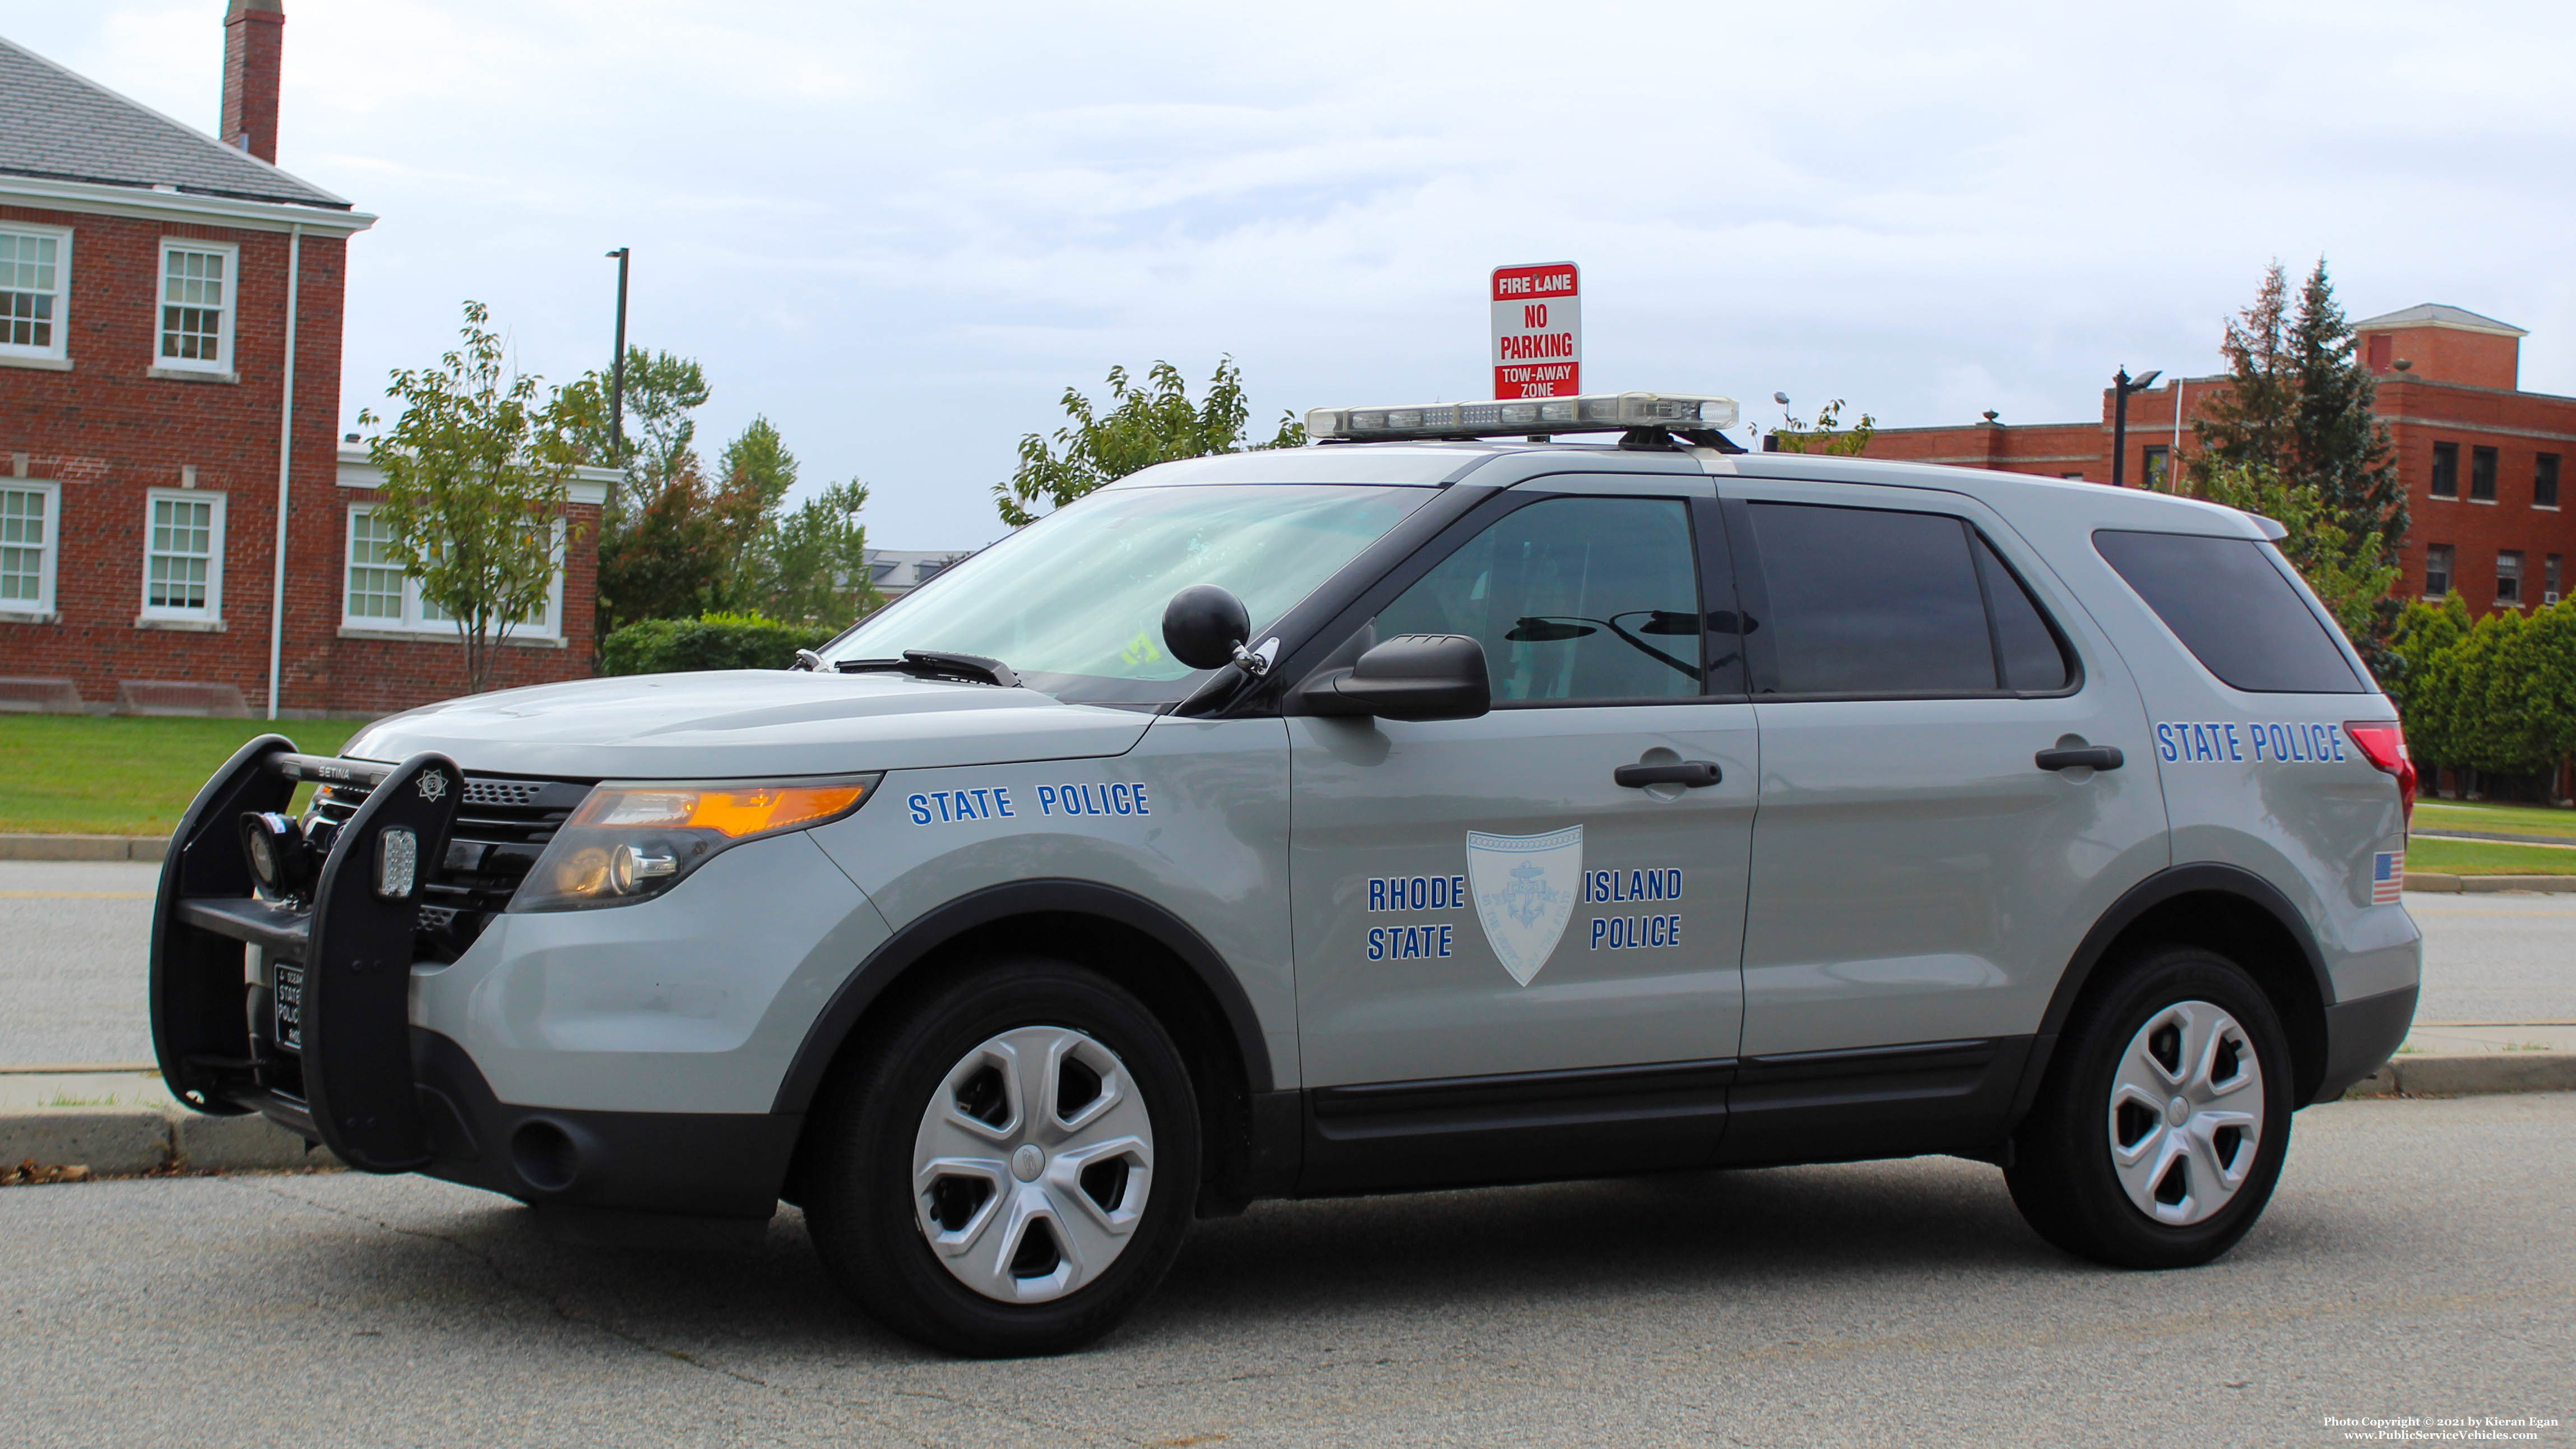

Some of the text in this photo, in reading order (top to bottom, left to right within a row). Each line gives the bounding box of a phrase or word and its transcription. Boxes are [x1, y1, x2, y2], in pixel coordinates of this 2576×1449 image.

[1499, 274, 1572, 294] FIRE LANE
[1525, 304, 1548, 328] NO
[1500, 332, 1573, 360] PARKING
[1502, 365, 1572, 383] TOW-AWAY
[1521, 382, 1554, 397] ZONE
[2156, 721, 2346, 763] STATE POLICE
[318, 766, 350, 780] SETINA
[906, 782, 1151, 827] STATE POLICE
[1368, 868, 1683, 913] RHODE ISLAND
[1367, 923, 1453, 962] STATE
[1590, 914, 1681, 951] POLICE
[278, 1003, 301, 1024] POLIC
